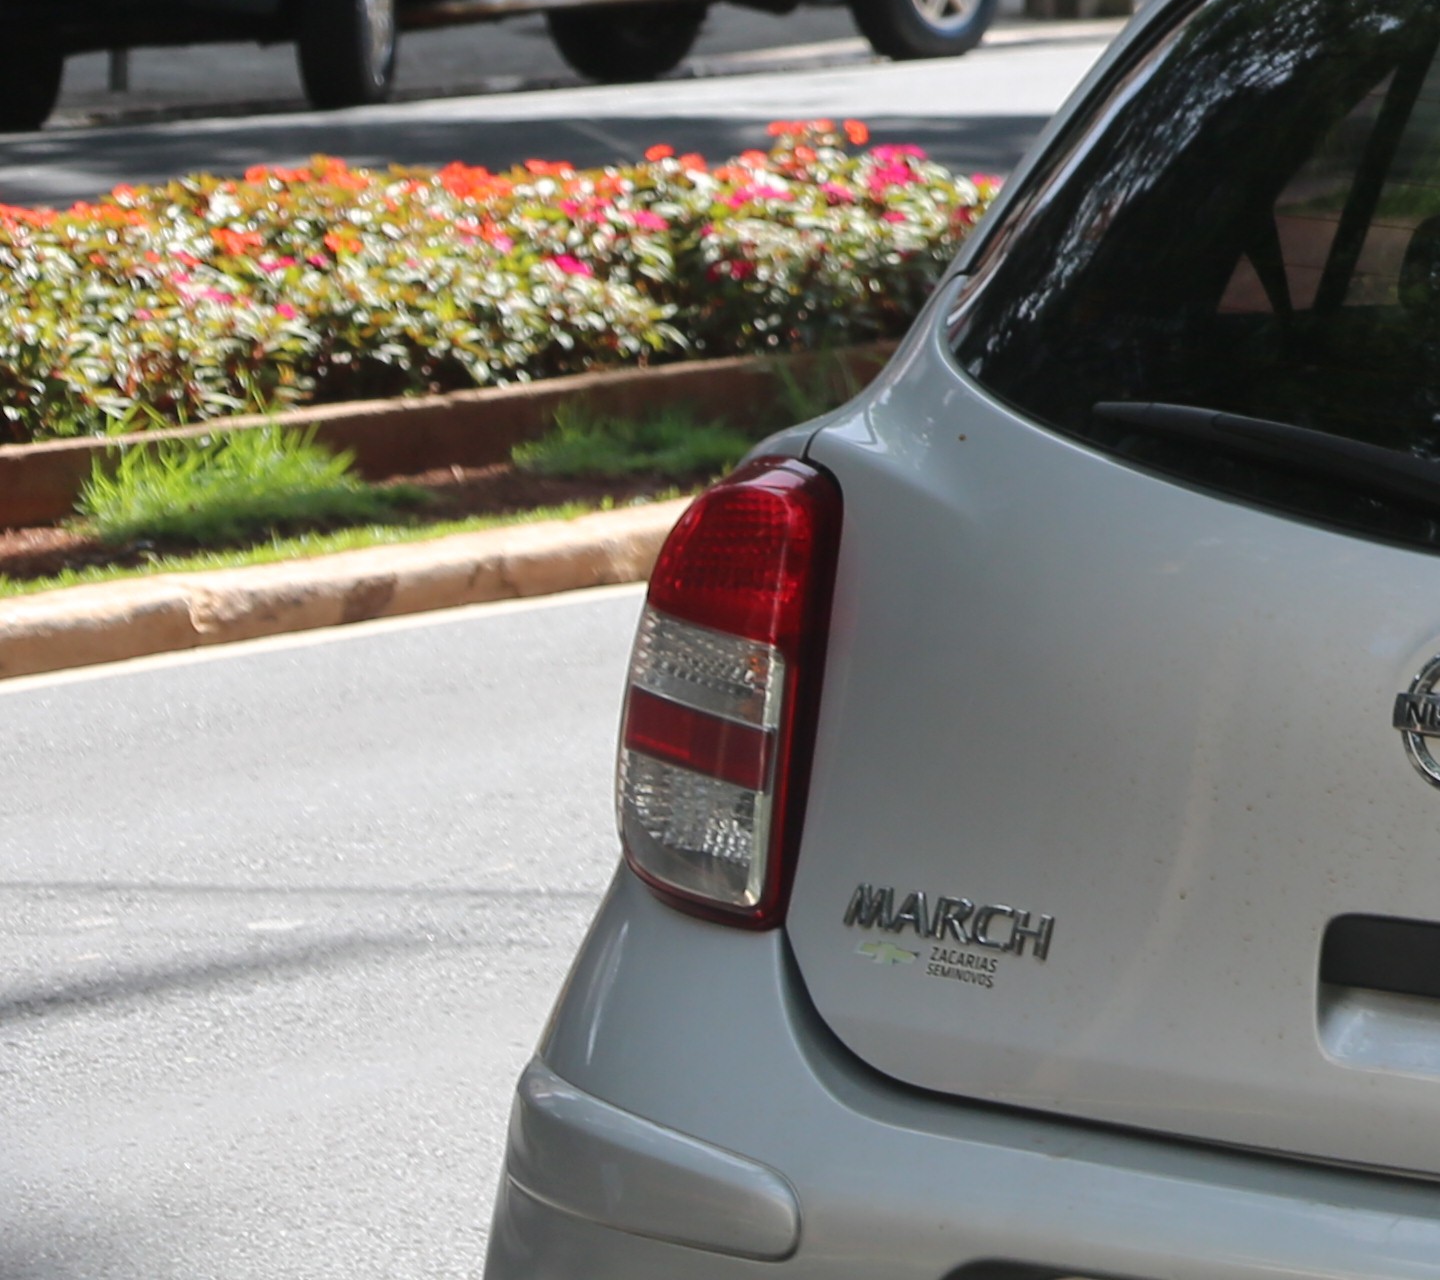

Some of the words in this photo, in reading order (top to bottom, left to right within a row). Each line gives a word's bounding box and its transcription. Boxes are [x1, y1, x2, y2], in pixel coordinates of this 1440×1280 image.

[843, 882, 1056, 962] MARCH
[929, 946, 998, 973] ZACARIAS
[925, 963, 995, 988] SEMINOVOS
